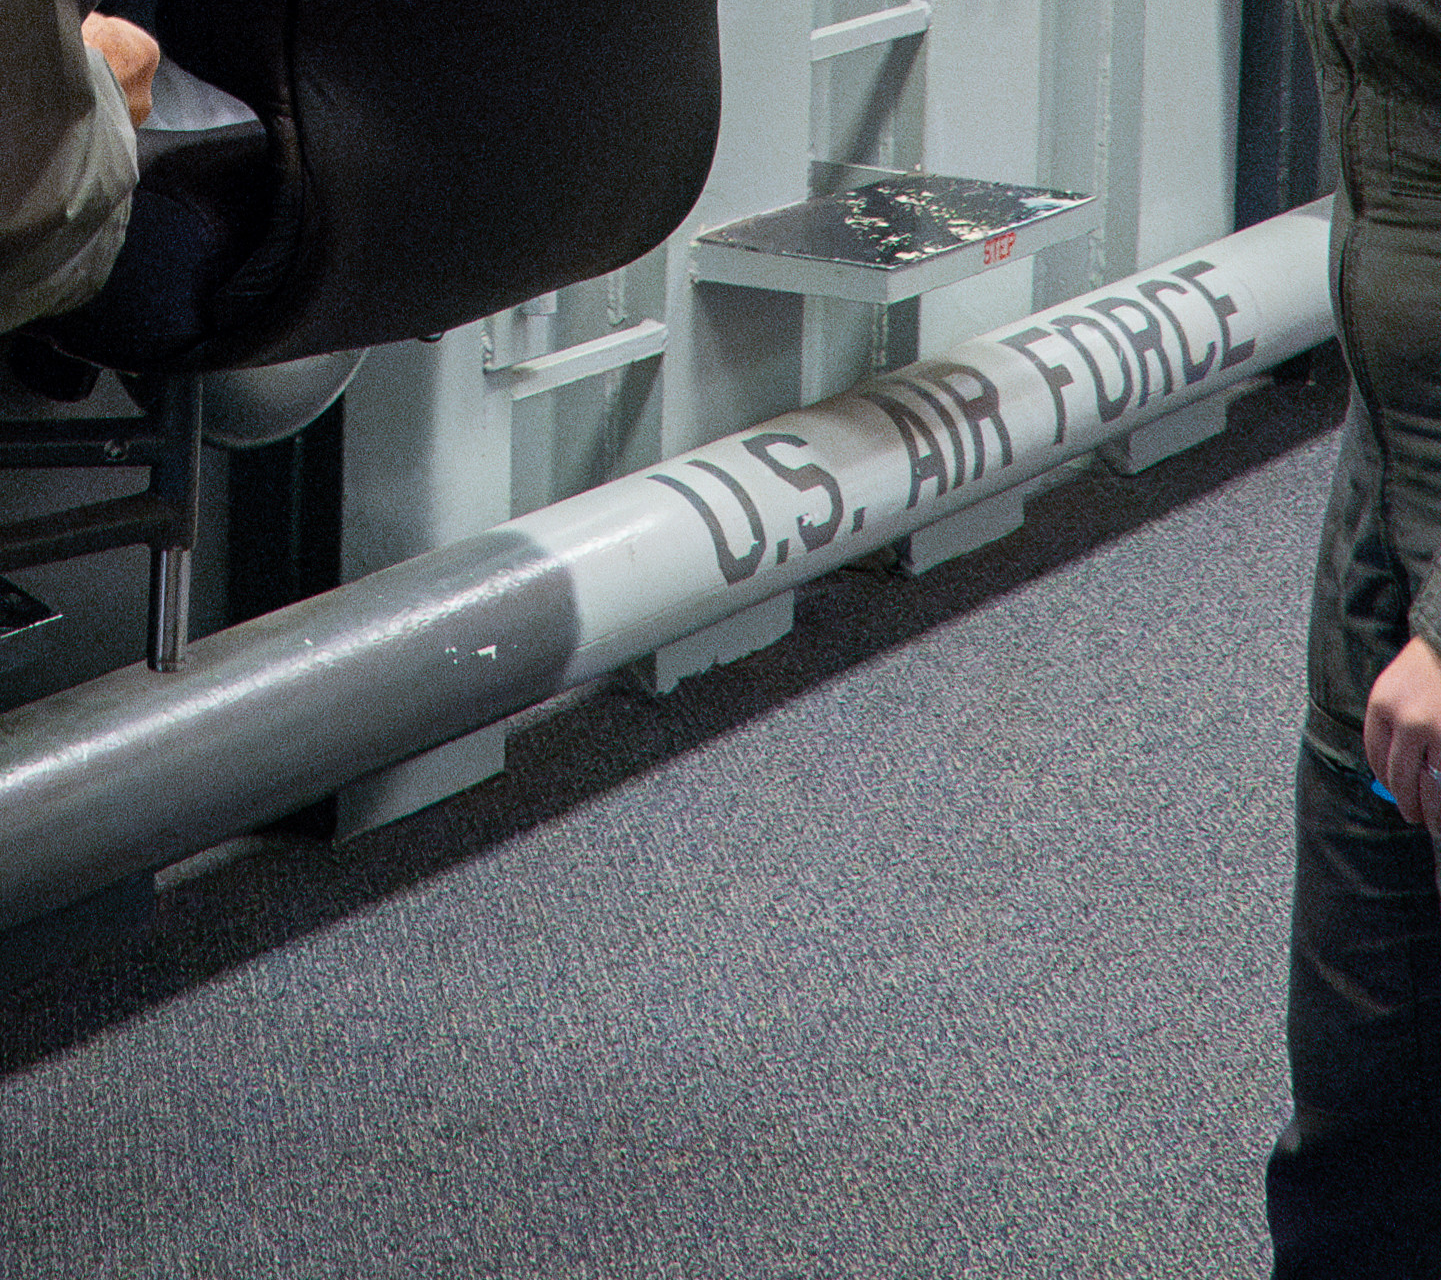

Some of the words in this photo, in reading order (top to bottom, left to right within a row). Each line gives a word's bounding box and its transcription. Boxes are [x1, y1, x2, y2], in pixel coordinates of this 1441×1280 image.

[983, 230, 1017, 266] STEP
[647, 432, 867, 586] U.S.
[861, 362, 1013, 510] AIR
[999, 260, 1256, 446] FORCE
